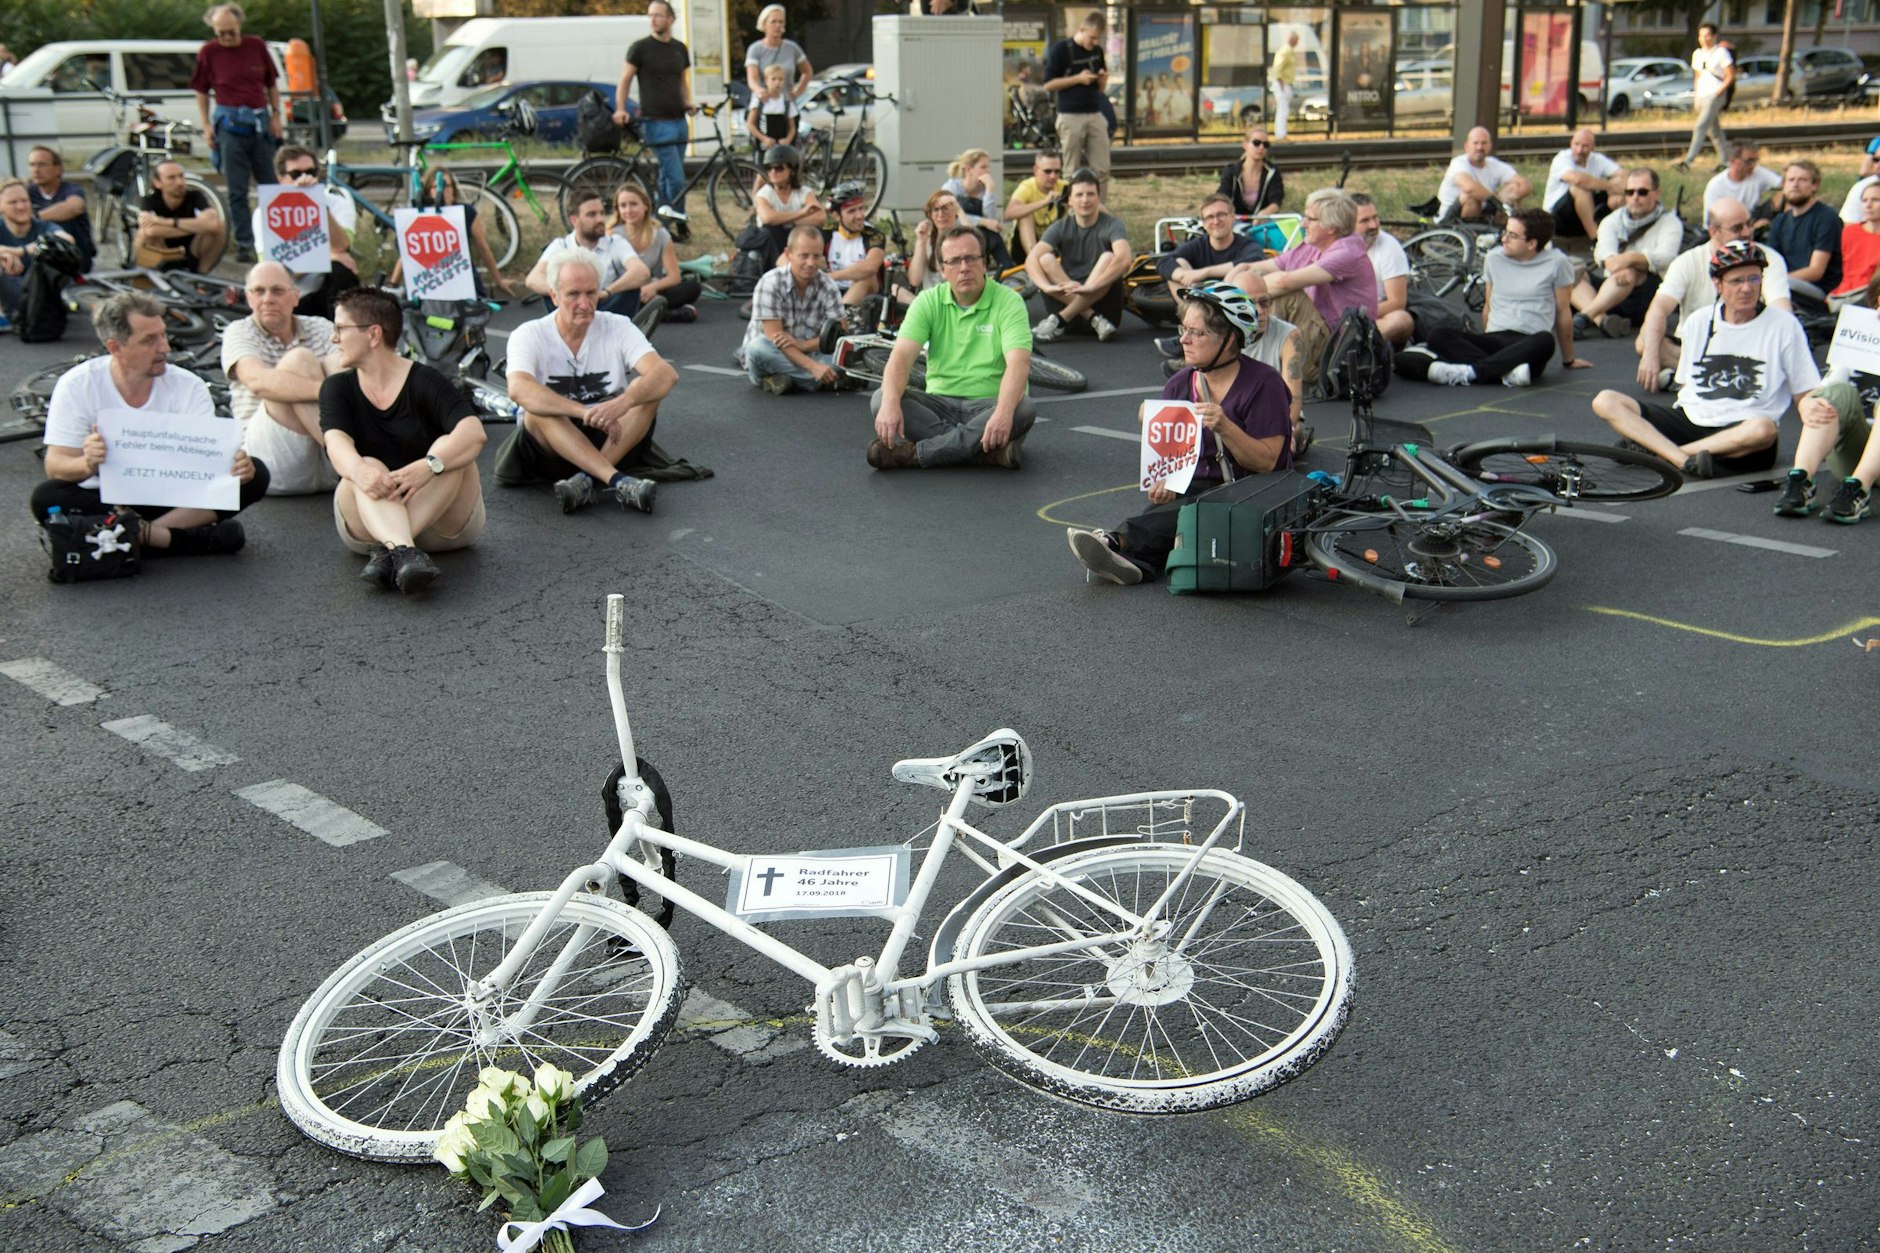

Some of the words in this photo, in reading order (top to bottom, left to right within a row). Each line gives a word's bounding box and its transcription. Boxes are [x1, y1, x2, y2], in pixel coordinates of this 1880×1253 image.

[269, 206, 318, 228] STOP
[271, 225, 322, 257] KILLING
[407, 230, 457, 255] STOP
[413, 249, 462, 286] KILLING
[411, 259, 469, 299] CYCLISTS
[122, 428, 217, 445] Hauptunfallursache
[1150, 422, 1197, 444] STOP
[115, 440, 147, 450] Fehler
[150, 441, 174, 453] beim
[177, 444, 223, 458] Abbiegen
[1147, 444, 1195, 475] KILLING
[122, 467, 156, 478] JETZT
[160, 469, 215, 480] HANDELN!
[1142, 454, 1198, 488] CYCLISTS
[797, 878, 816, 886] 46
[819, 878, 860, 887] Jahre
[799, 868, 870, 877] Radfahrer
